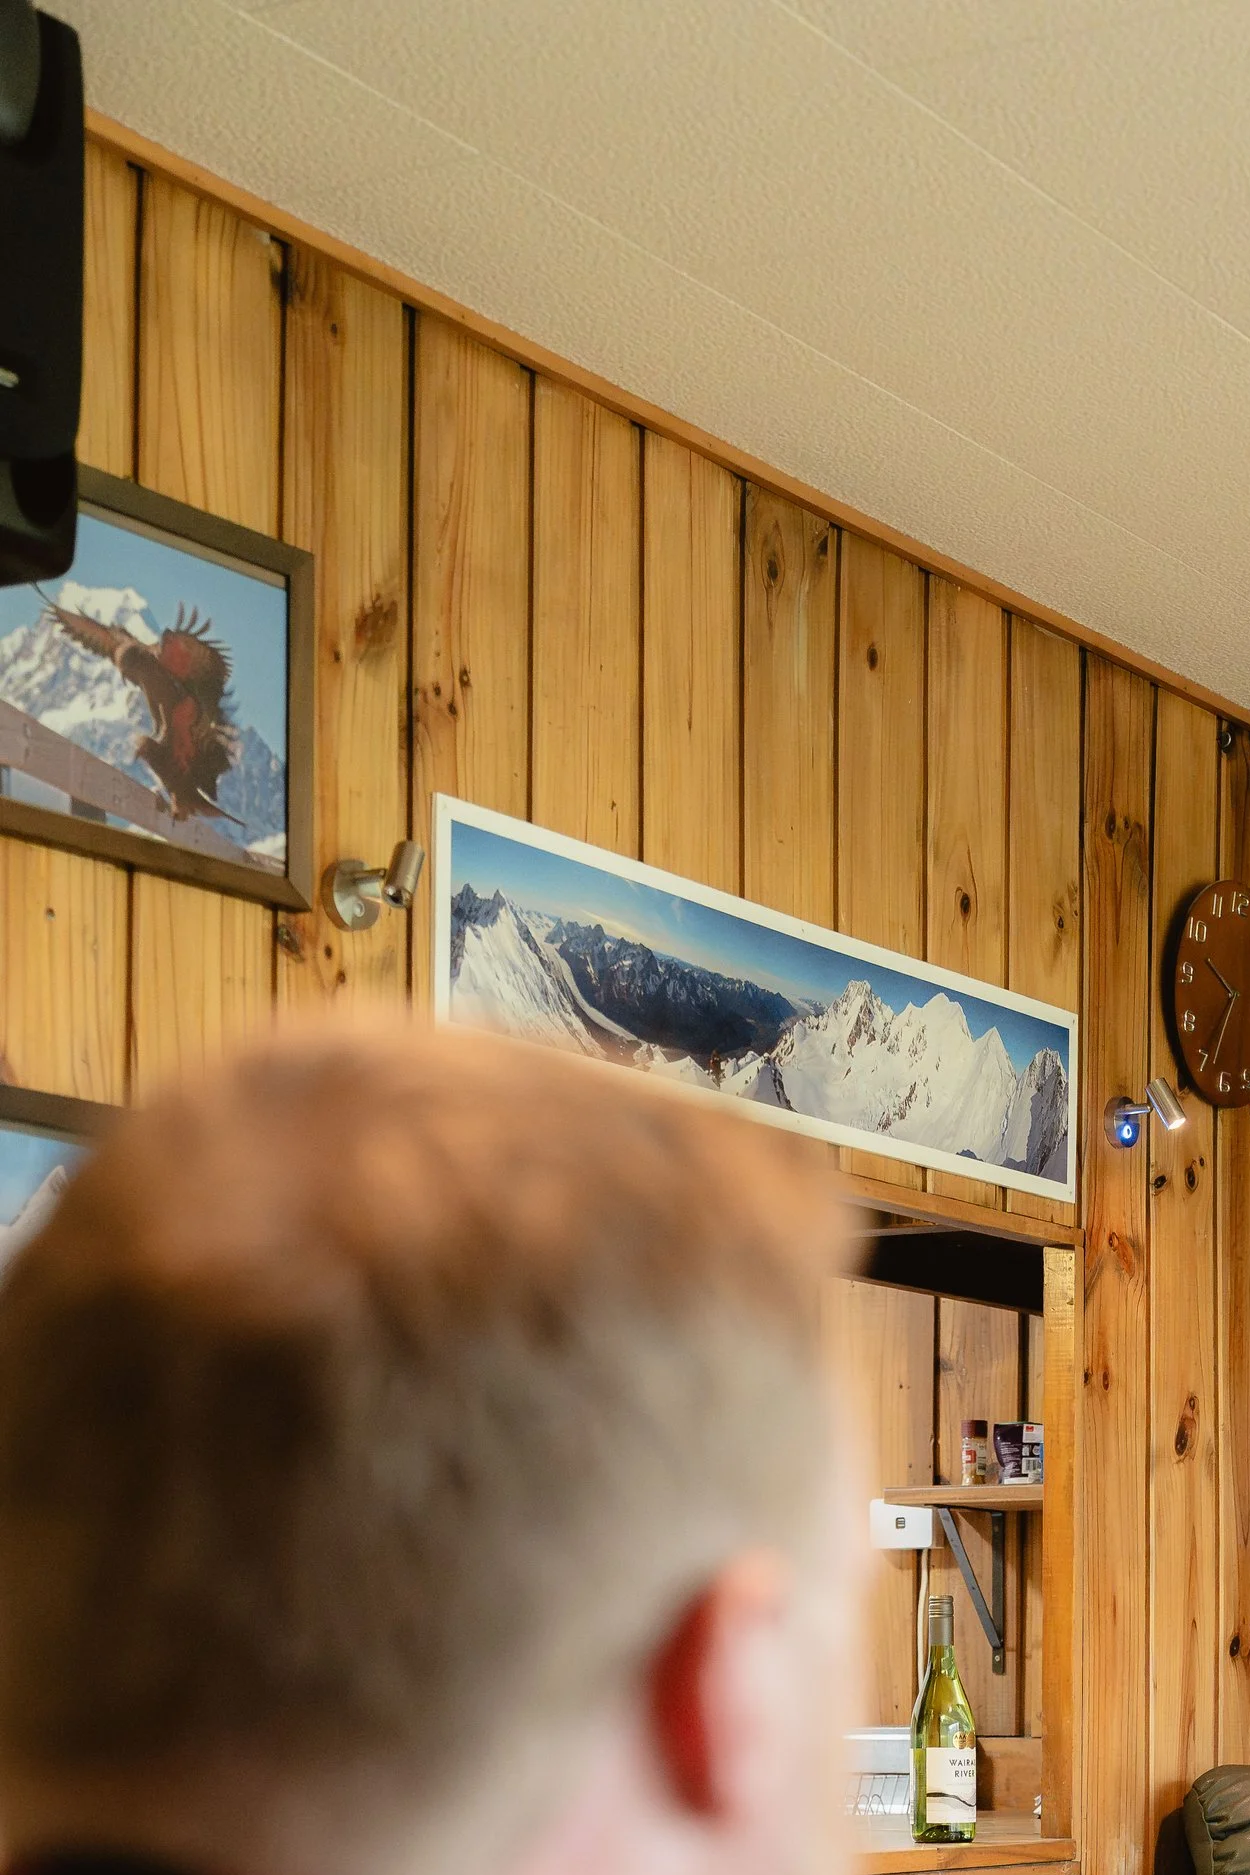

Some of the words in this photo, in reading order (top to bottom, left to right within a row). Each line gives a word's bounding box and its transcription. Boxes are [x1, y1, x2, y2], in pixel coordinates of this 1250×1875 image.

[1212, 893, 1223, 918] 11
[1232, 891, 1250, 918] 12
[1189, 917, 1207, 943] 10
[1181, 961, 1193, 984] 9
[1184, 1010, 1196, 1032] 8
[1198, 1048, 1209, 1072] 7
[1219, 1071, 1231, 1092] 6
[949, 1759, 976, 1767] WAIRA
[954, 1770, 975, 1778] RIVER
